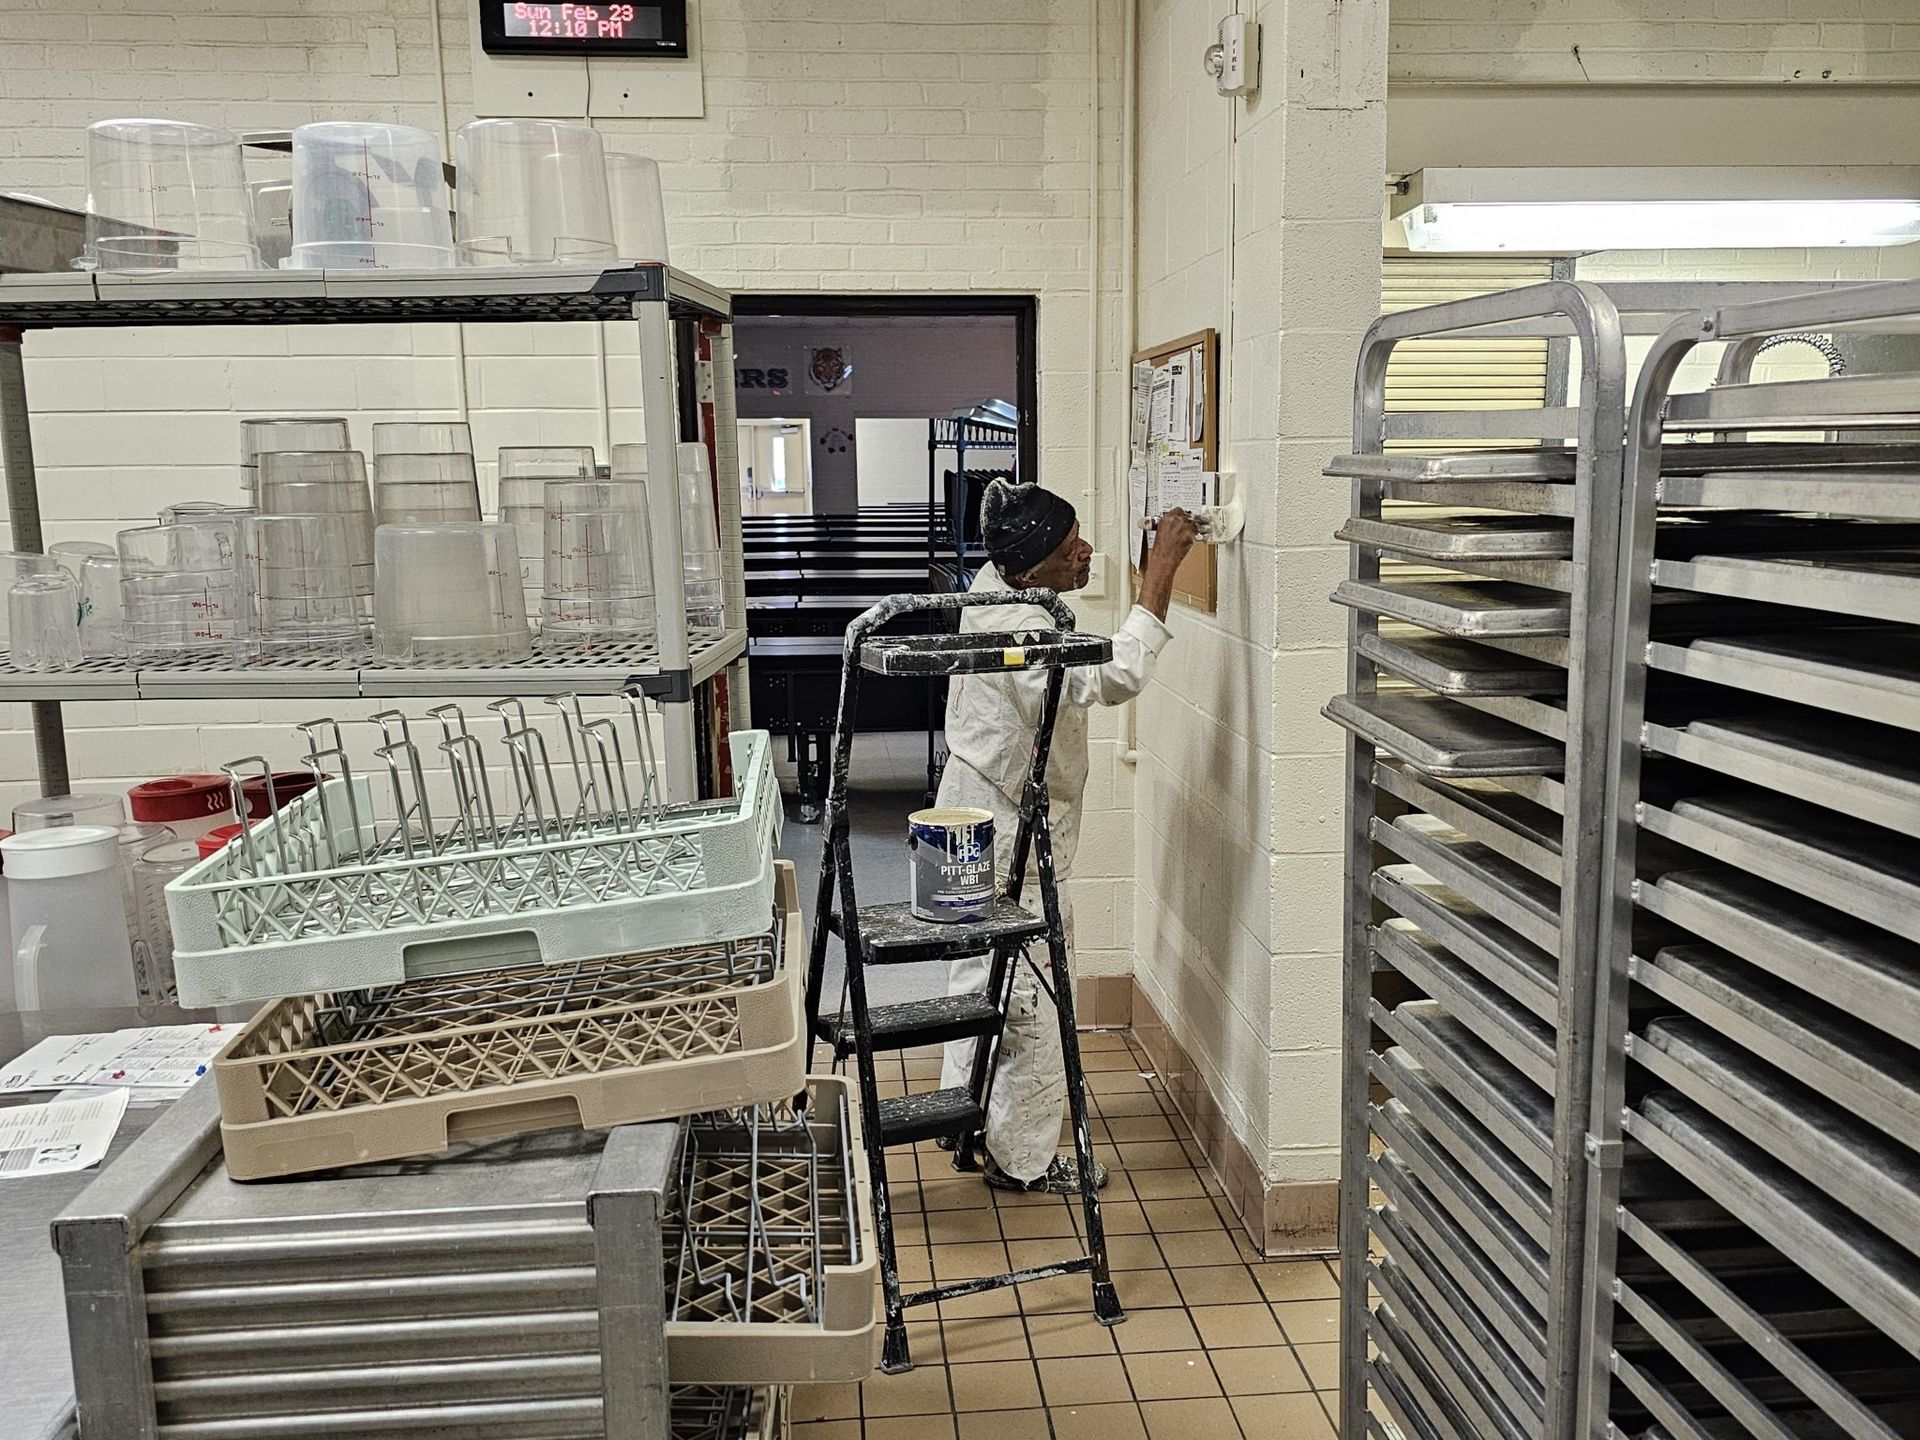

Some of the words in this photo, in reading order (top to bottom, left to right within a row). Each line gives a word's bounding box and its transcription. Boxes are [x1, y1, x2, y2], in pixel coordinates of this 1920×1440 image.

[514, 2, 551, 20] Sun
[561, 3, 599, 21] Feb
[608, 4, 634, 21] 23
[528, 19, 588, 37] 12:10
[598, 20, 624, 38] PM
[940, 860, 991, 876] PITT-GLAZE
[960, 874, 979, 886] WB1
